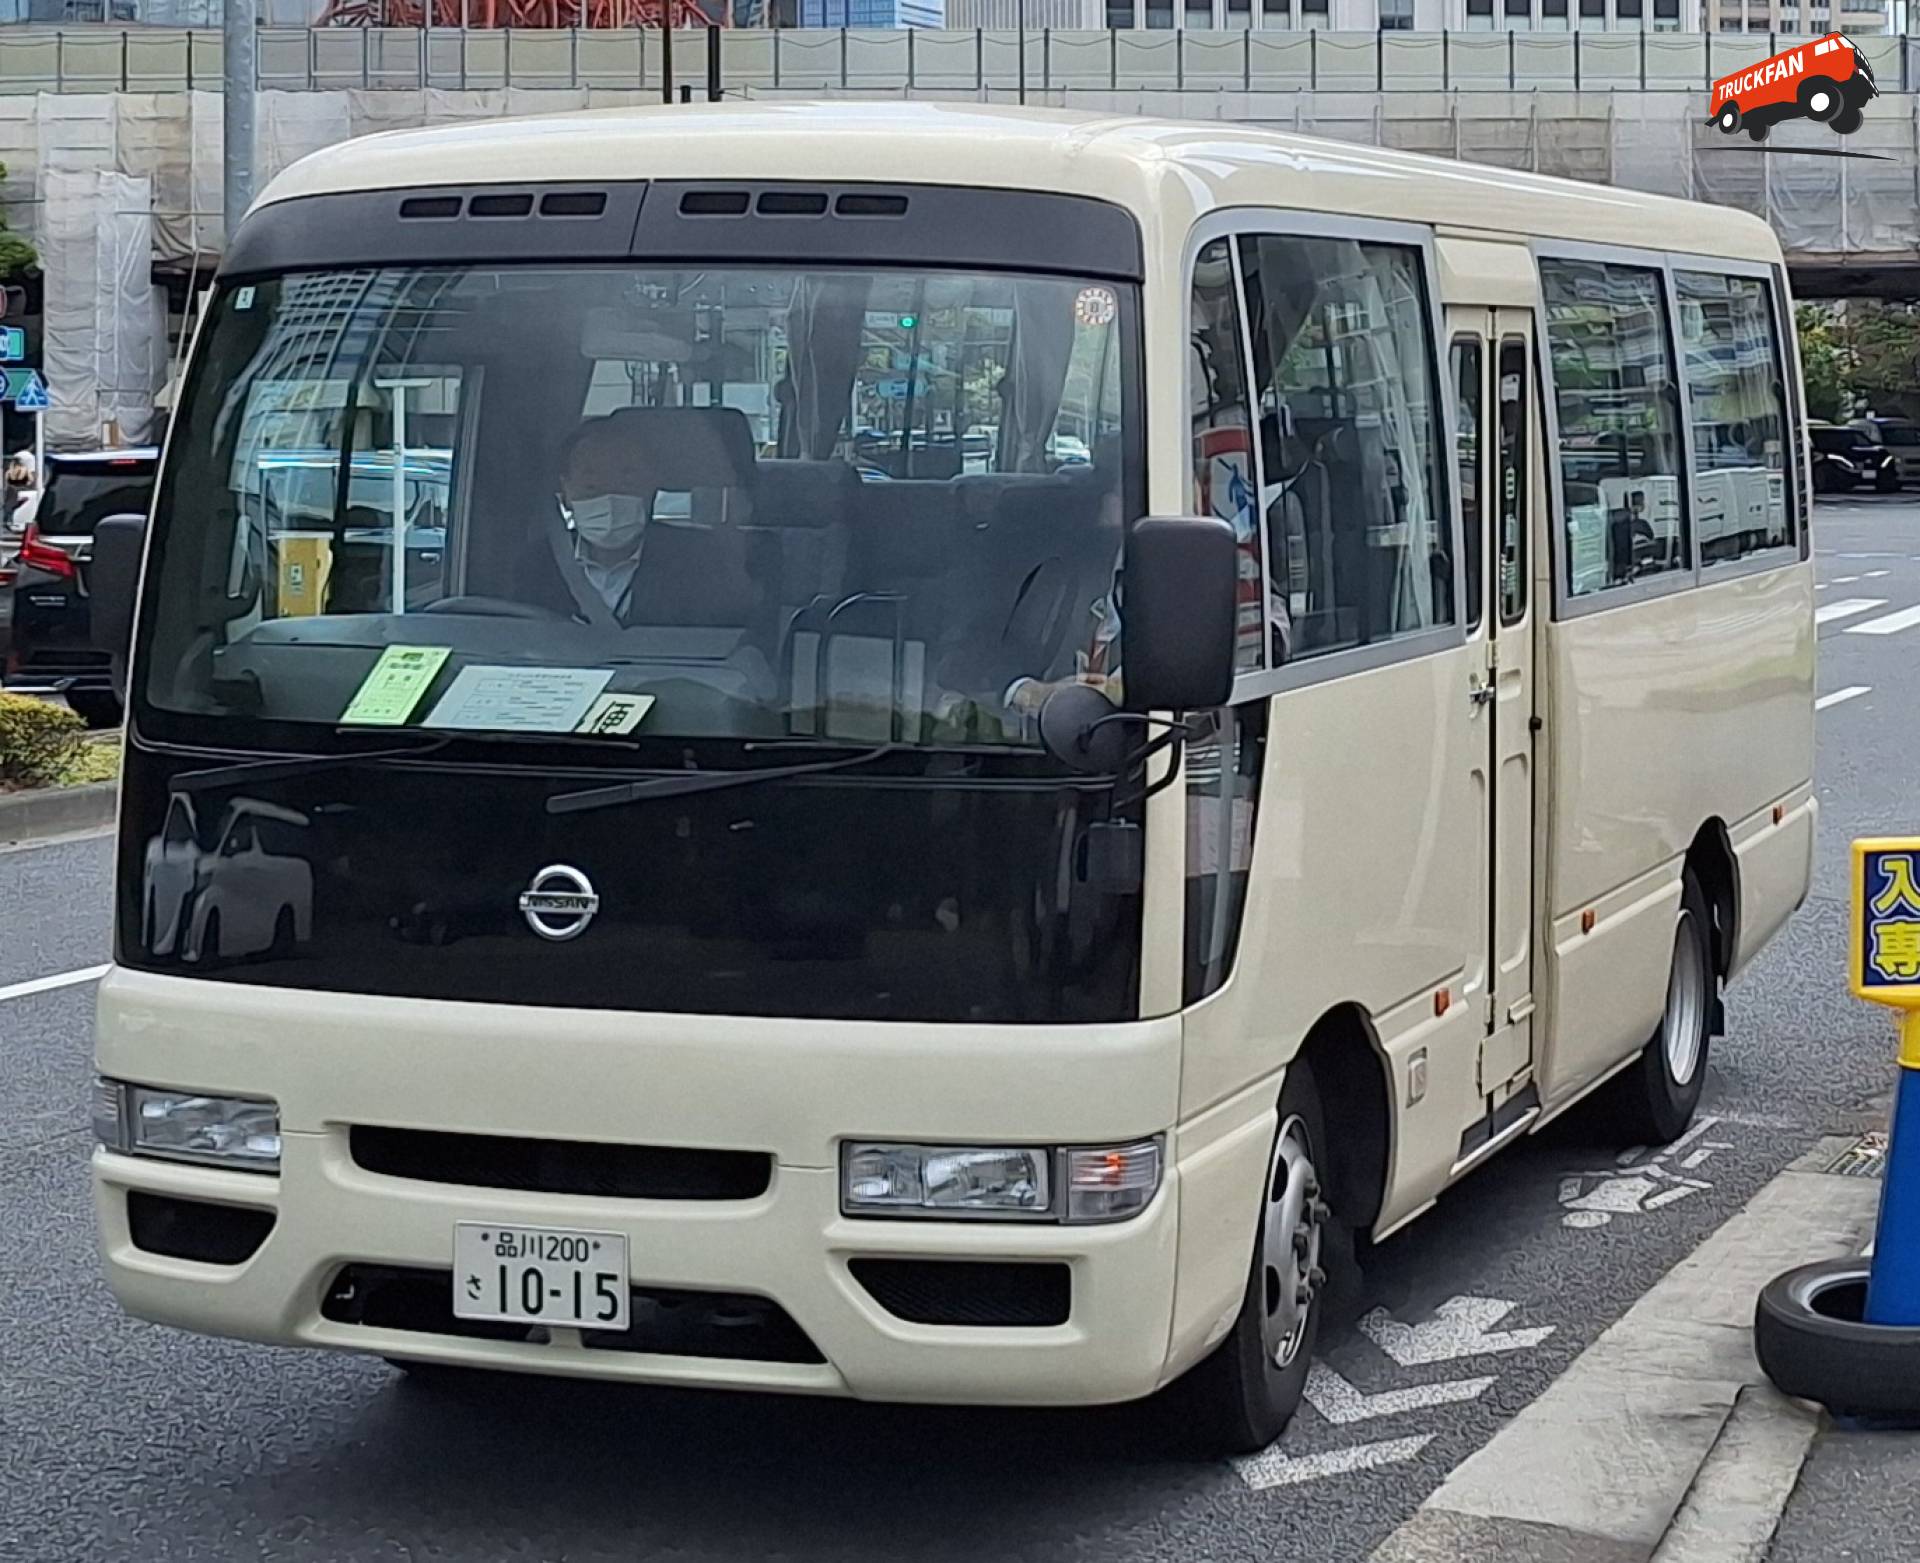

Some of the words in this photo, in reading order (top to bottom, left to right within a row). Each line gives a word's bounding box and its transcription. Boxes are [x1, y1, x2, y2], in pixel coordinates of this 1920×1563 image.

[526, 895, 595, 909] NISSAN
[1872, 856, 1920, 916] 入
[466, 1274, 481, 1300] さ
[500, 1265, 618, 1321] 10-15
